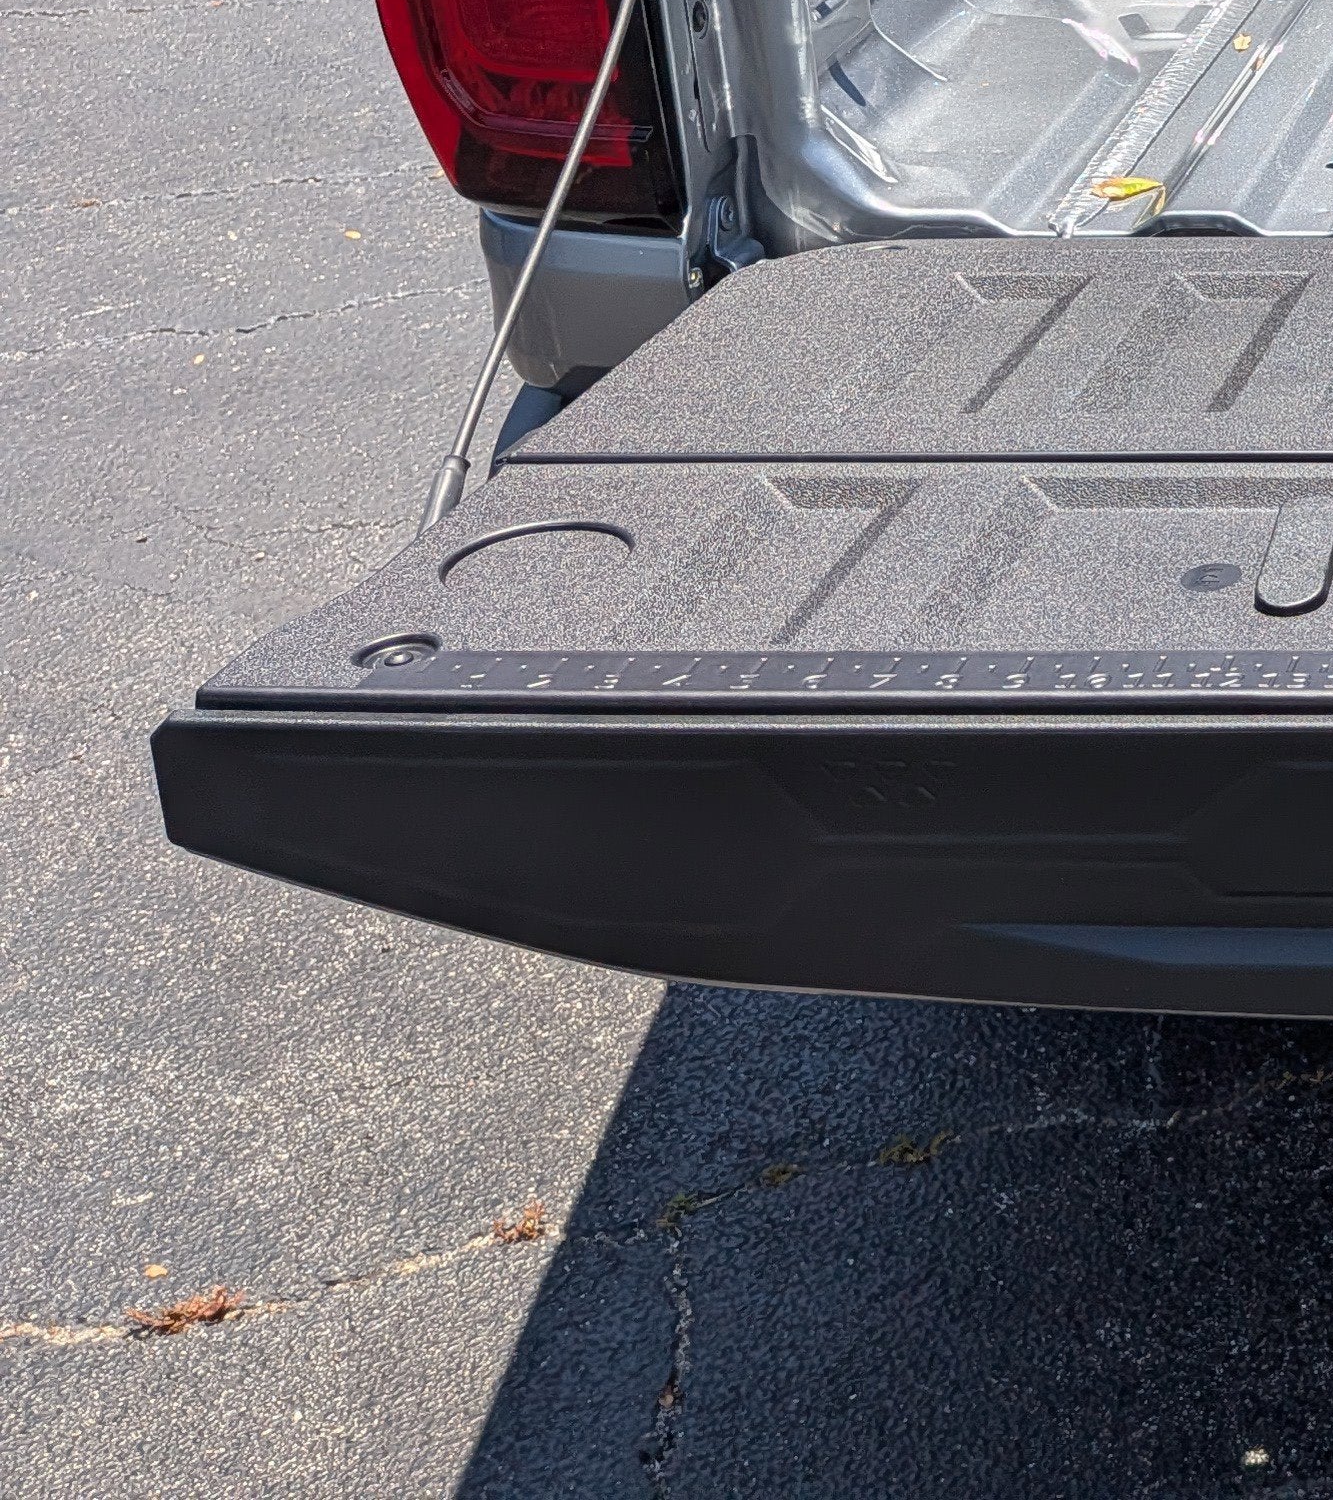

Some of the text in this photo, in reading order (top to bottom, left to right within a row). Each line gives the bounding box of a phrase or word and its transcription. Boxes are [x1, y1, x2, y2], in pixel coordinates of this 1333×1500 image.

[869, 674, 898, 688] 7
[1055, 673, 1110, 688] 10
[1122, 673, 1175, 688] 11
[1190, 673, 1245, 688] 12
[1258, 673, 1311, 688] 13
